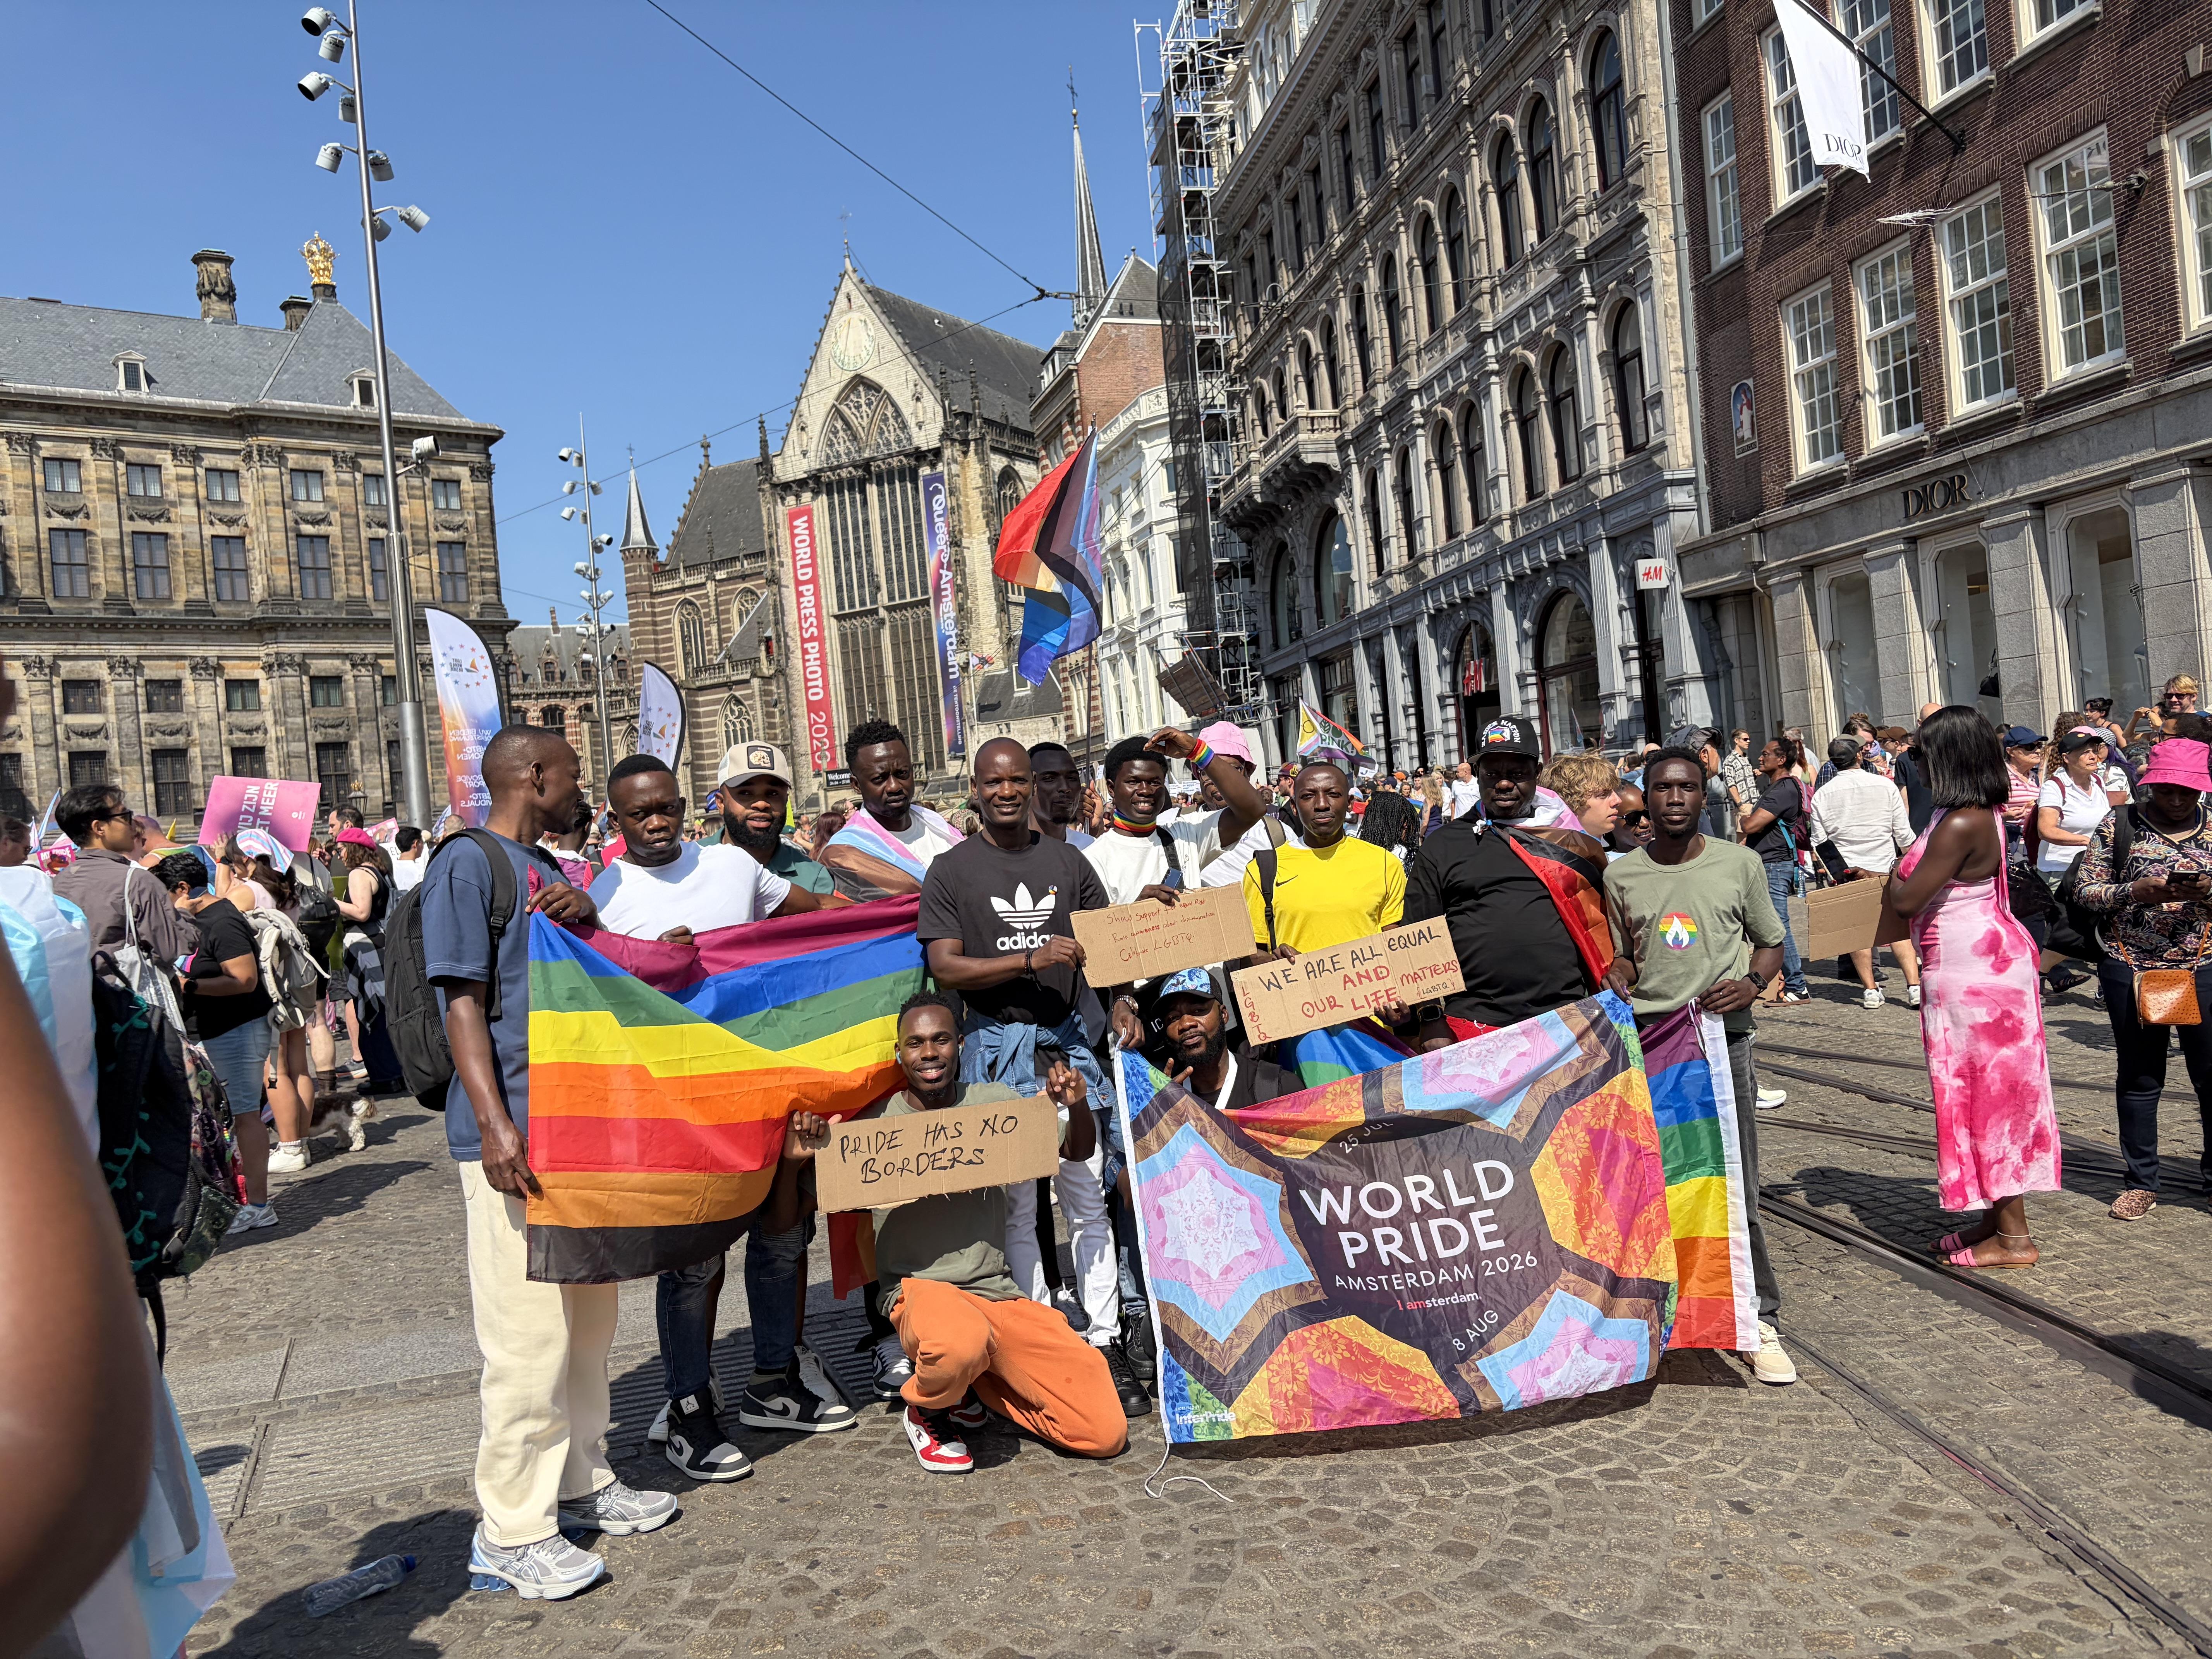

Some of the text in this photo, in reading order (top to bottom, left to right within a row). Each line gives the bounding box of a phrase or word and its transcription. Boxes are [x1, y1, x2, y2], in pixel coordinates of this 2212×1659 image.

[1822, 134, 1863, 164] DIOR
[1901, 474, 1972, 518] DIOR
[793, 515, 812, 580] WORLD
[798, 584, 817, 639] PRESS
[803, 642, 823, 702] PHOTO
[1320, 733, 1355, 754] PINK!
[1500, 720, 1522, 743] NATION
[241, 785, 260, 812] ZIJN
[259, 781, 279, 816] MEER
[40, 851, 50, 860] MY
[1107, 912, 1132, 924] Show
[1112, 933, 1128, 943] Raise
[1130, 924, 1160, 937] awareness
[1163, 920, 1178, 928] about
[996, 932, 1055, 951] adida
[1258, 926, 1441, 992] WE ARE ALL EQUAL
[1400, 960, 1458, 987] MATTERS
[1343, 965, 1390, 991] AND
[1301, 987, 1398, 1018] OUR LIFE
[839, 1113, 1018, 1164] PRIDE HAS NO
[1340, 1122, 1394, 1154] 25 JUL
[860, 1146, 985, 1184] BORDERS
[1300, 1159, 1515, 1226] WORLD
[1337, 1208, 1506, 1269] PRIDE
[1335, 1250, 1538, 1292] AMSTERDAM 2026
[1396, 1300, 1404, 1311] I
[1452, 1310, 1499, 1351] 8 AUG
[1176, 1410, 1236, 1425] InterPride
